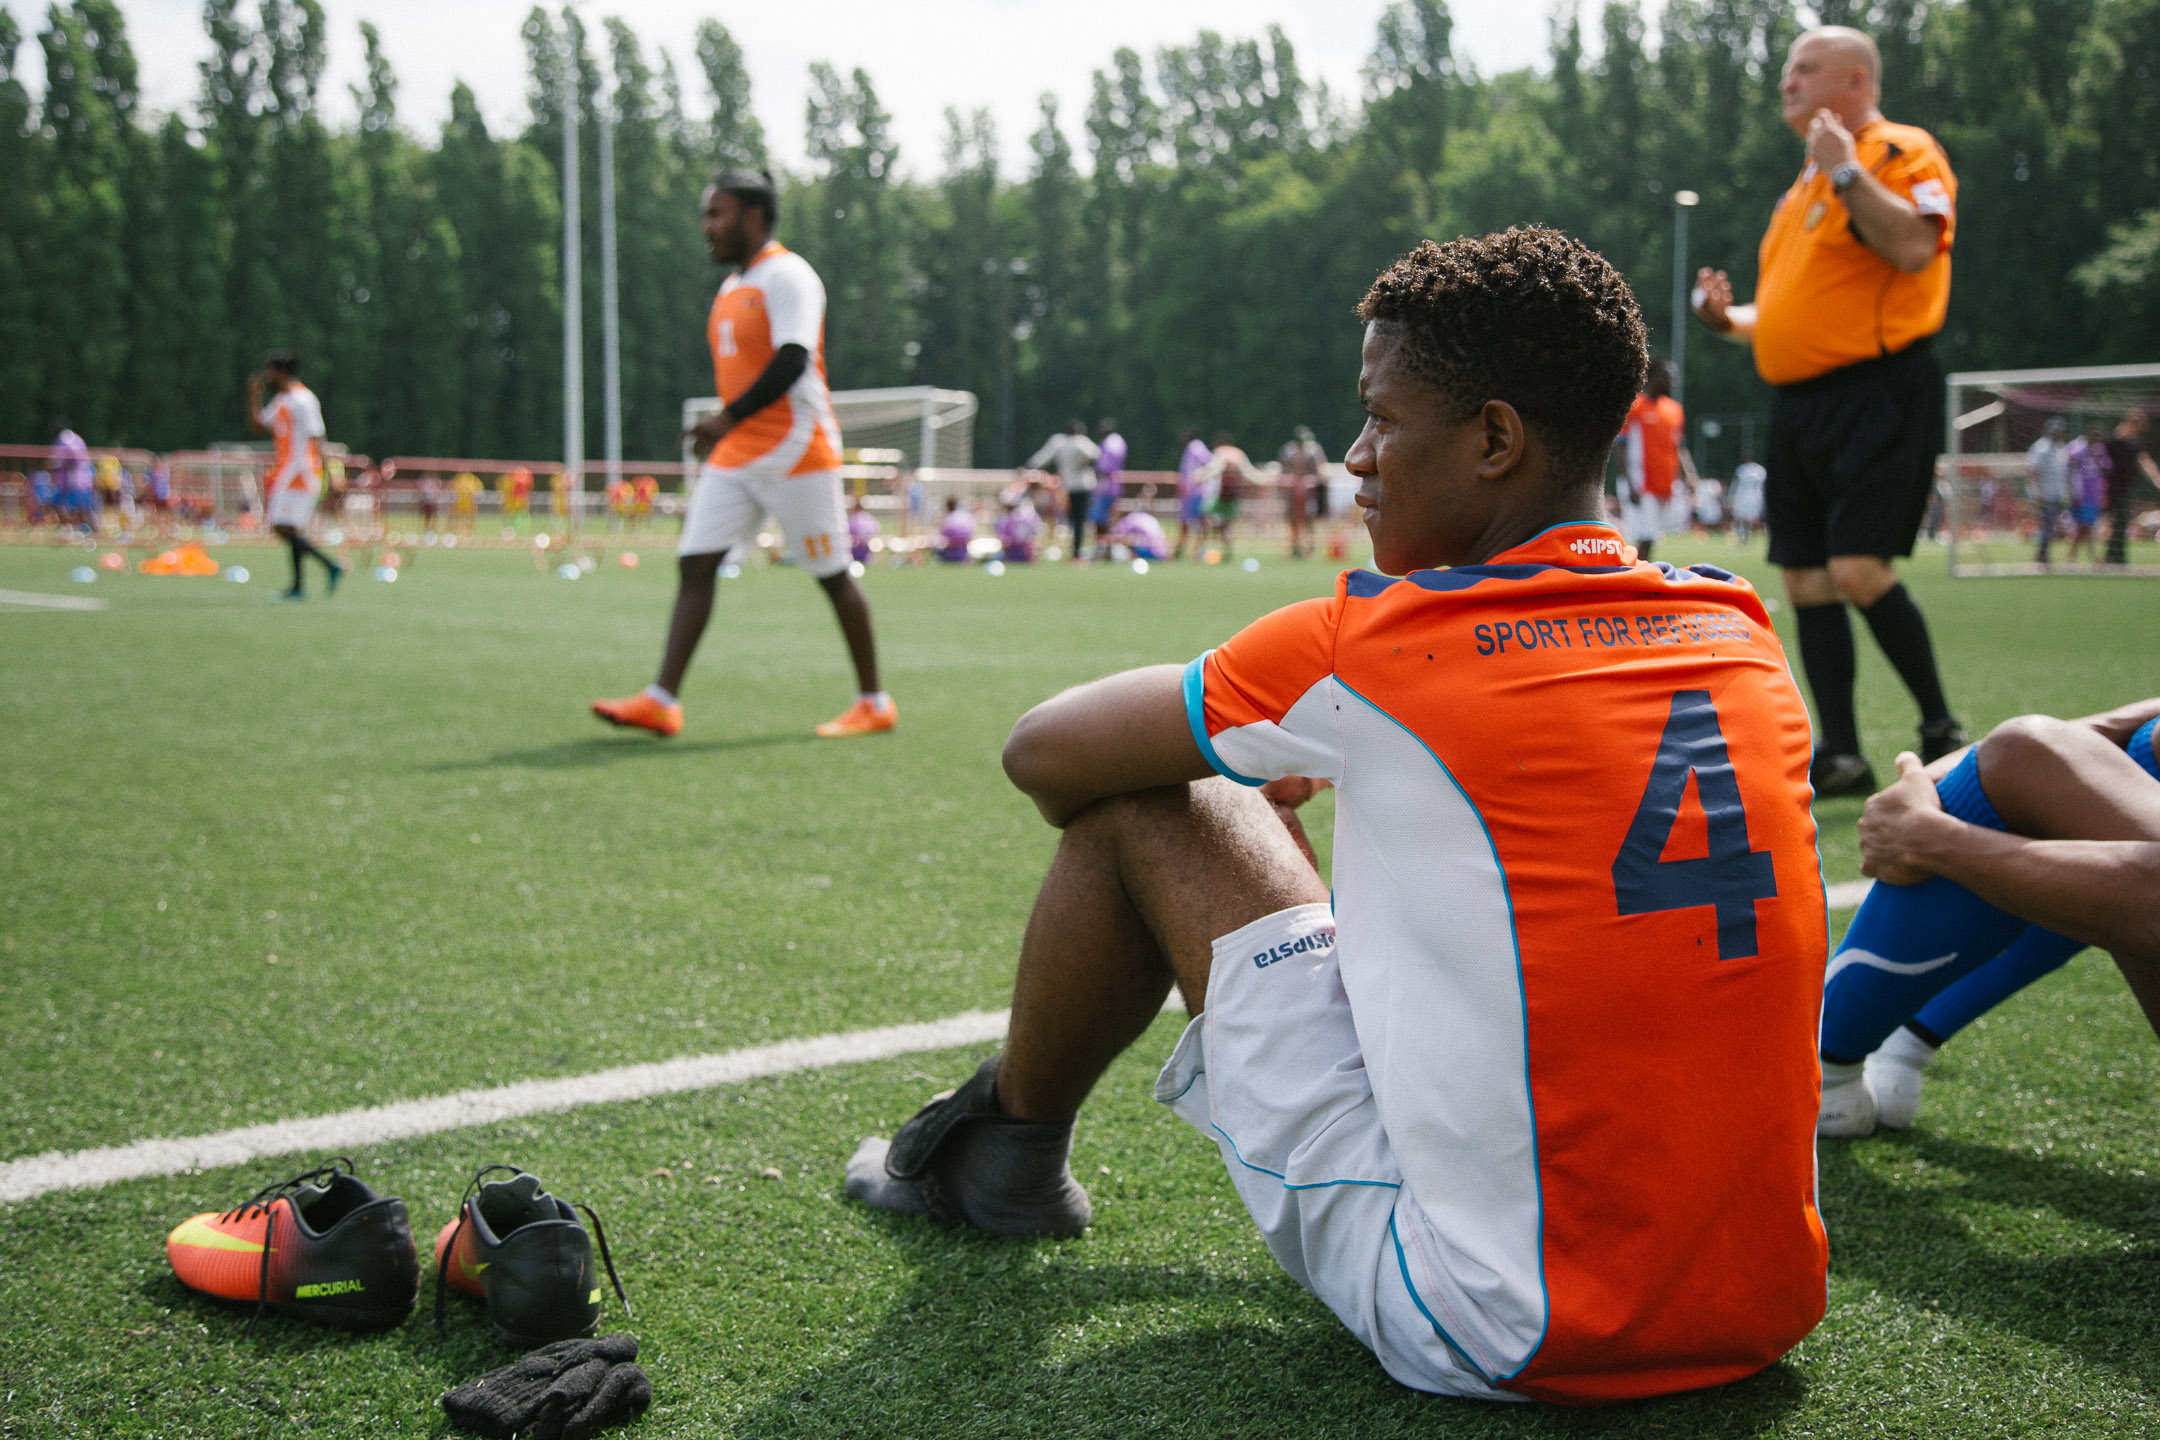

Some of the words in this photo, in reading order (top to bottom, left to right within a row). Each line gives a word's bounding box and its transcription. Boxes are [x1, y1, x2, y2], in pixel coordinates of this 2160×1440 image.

[1571, 539, 1623, 555] KIPST
[1475, 619, 1572, 656] SPORT
[1578, 617, 1637, 647] FOR
[1635, 613, 1751, 646] REFUGEES
[1612, 690, 1777, 960] 4
[295, 1279, 366, 1299] MERCURIAL
